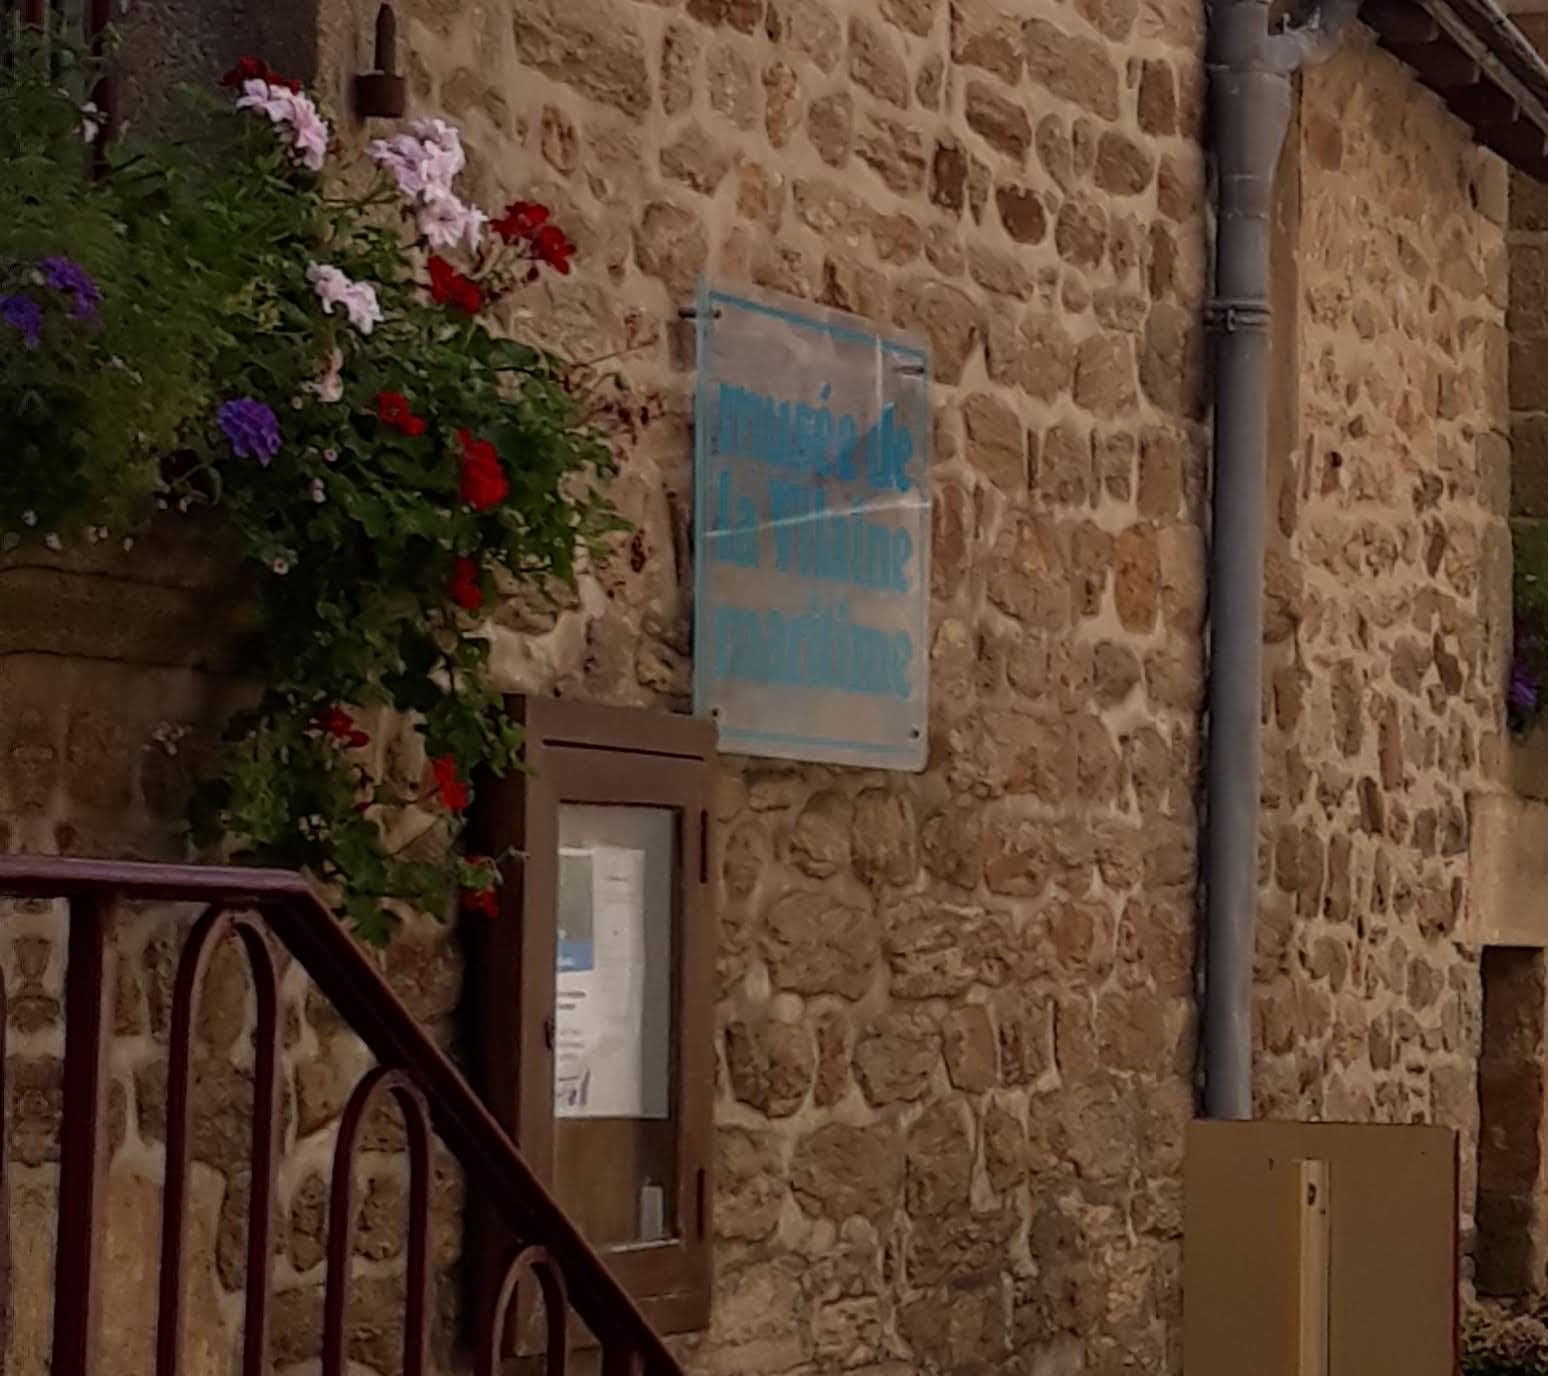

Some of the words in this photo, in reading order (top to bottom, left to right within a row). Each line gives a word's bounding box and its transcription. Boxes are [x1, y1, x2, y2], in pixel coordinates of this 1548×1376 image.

[866, 401, 914, 493] de
[716, 465, 760, 569] la
[767, 476, 913, 593] Vilaine
[713, 591, 914, 701] maritime
